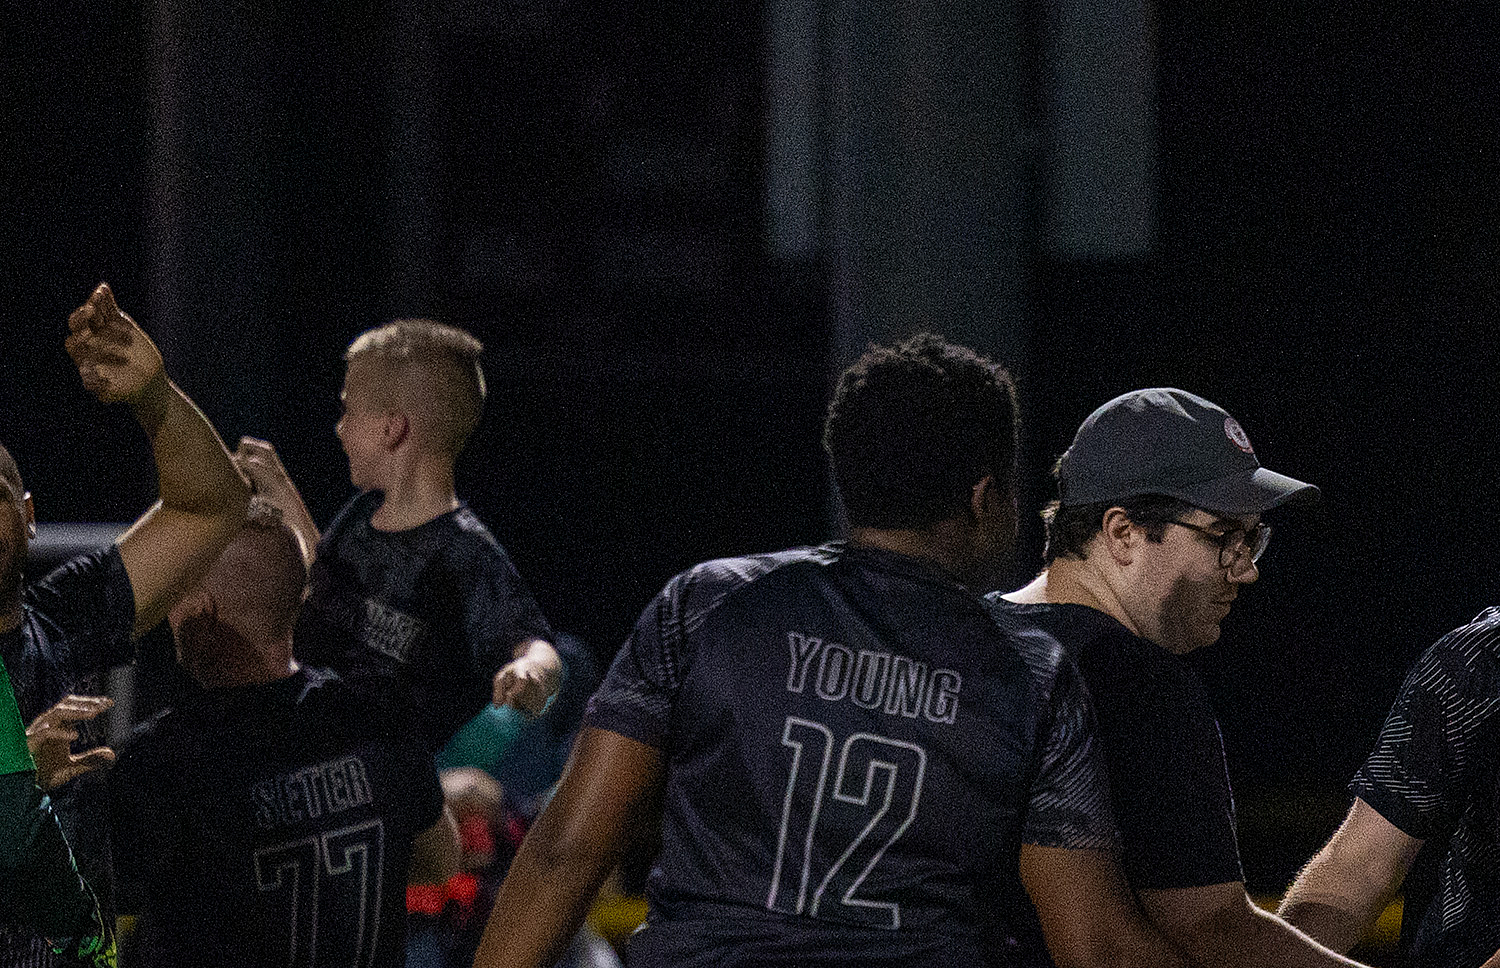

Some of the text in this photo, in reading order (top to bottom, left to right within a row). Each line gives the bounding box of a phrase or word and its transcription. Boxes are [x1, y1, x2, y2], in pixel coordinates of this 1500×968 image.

[786, 631, 962, 725] YOUNG
[251, 755, 374, 829] SETER
[766, 716, 927, 930] 12
